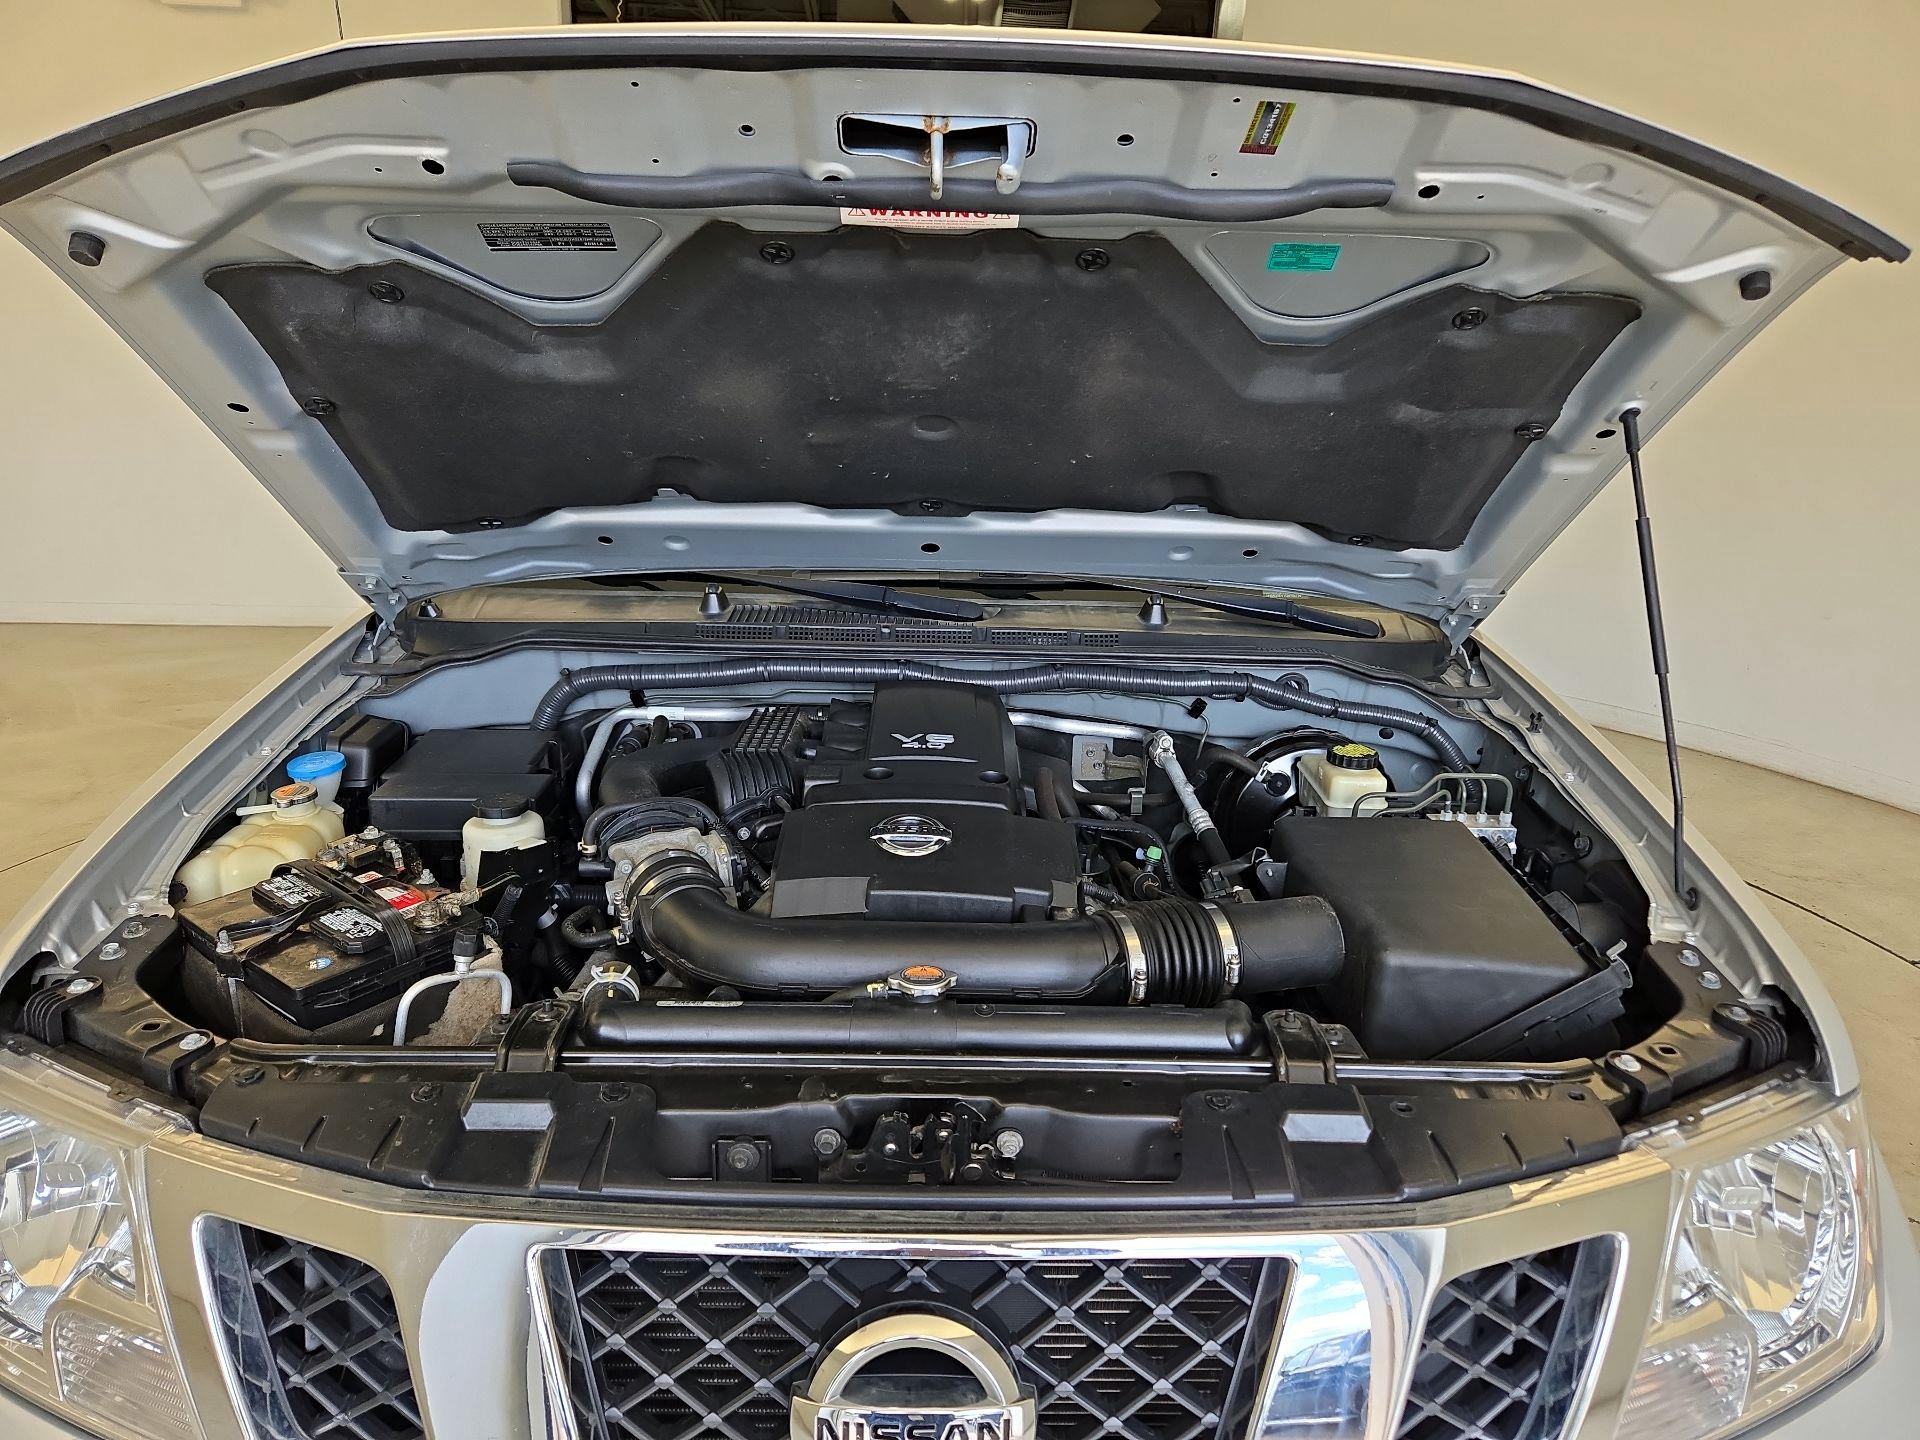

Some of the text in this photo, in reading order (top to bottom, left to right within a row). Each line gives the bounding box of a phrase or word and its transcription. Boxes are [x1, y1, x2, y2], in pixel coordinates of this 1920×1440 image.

[869, 208, 989, 219] WARNING
[890, 733, 955, 743] V6
[901, 742, 946, 750] 4.0
[814, 1415, 1012, 1440] NISSAN
